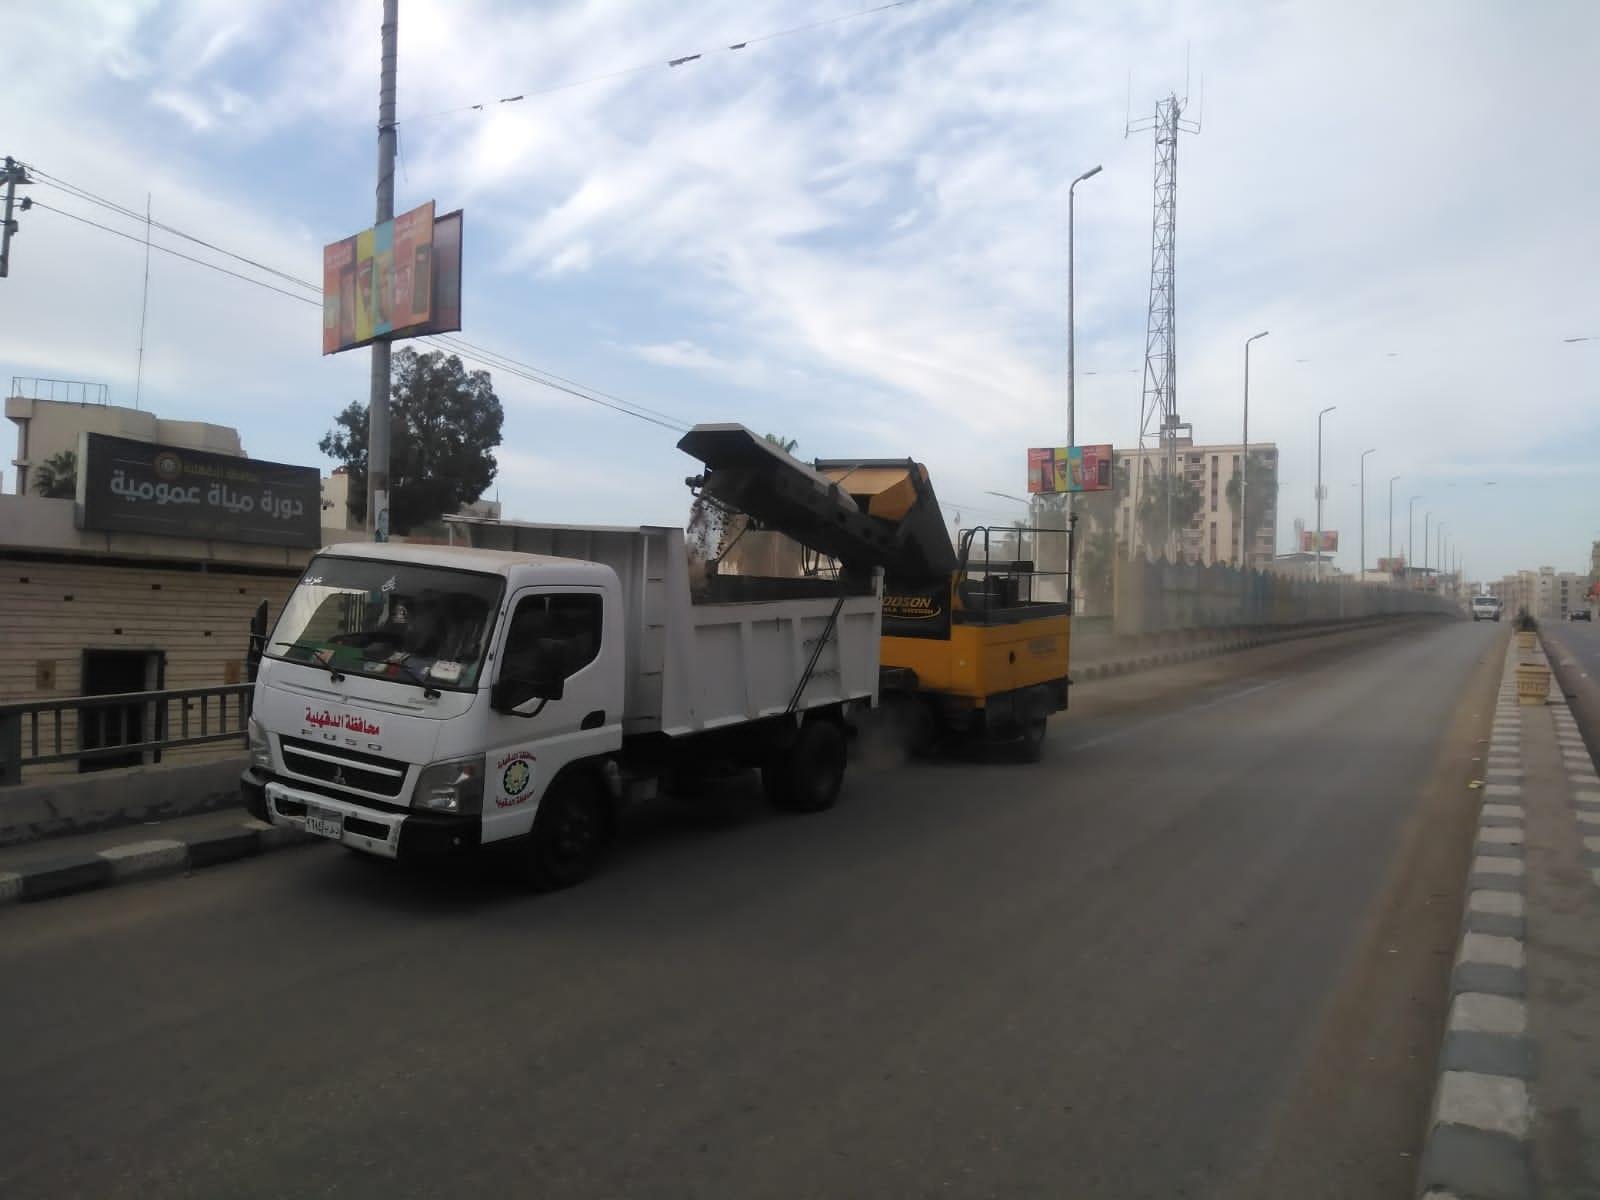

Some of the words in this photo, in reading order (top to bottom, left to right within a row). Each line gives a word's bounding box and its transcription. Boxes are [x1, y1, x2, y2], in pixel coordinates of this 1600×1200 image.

[110, 469, 201, 505] عمومية
[260, 489, 304, 519] دورة
[305, 706, 344, 729] الدقهلية
[345, 714, 380, 736] محافظة
[301, 728, 383, 751] FUSO
